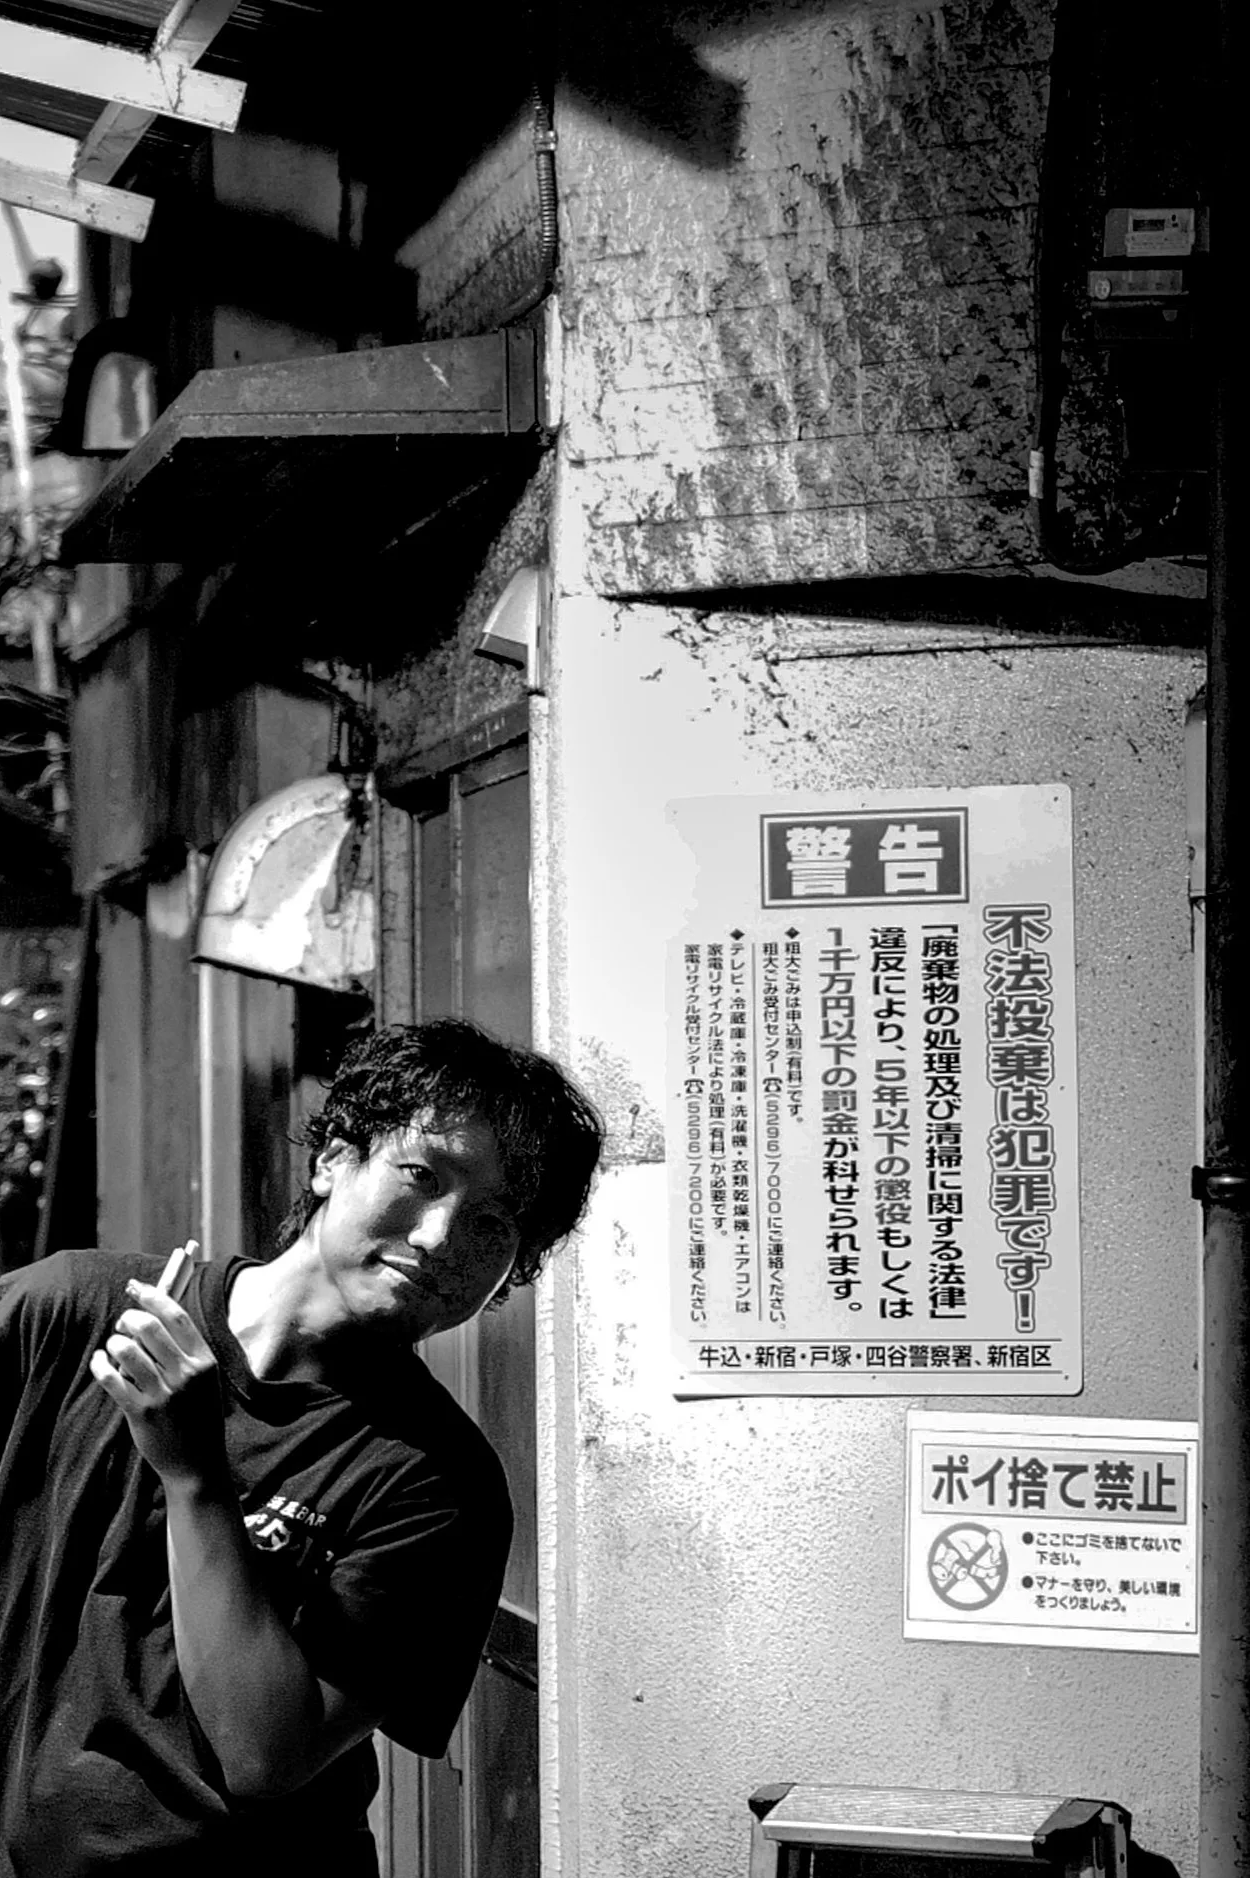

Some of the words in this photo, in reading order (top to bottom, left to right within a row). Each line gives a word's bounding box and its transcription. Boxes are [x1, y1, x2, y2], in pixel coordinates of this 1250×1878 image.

[786, 824, 944, 896] 警告
[818, 927, 862, 1311] 1千万円以下の罰金が科せられます。
[869, 926, 914, 1319] 違反により、5年以下の懲役もしくは
[921, 924, 967, 1319] 「廃棄物の処理及び清掃に関する法律」
[983, 904, 1057, 1333] 不法投棄は犯罪です!
[699, 1345, 1052, 1368] 牛込・新宿・戸塚・四谷警察署、新宿区
[932, 1454, 1177, 1513] ポイ捨て禁止
[1036, 1532, 1182, 1552] ここにゴミを捨てないで
[1036, 1550, 1081, 1566] 下さい。
[1035, 1575, 1181, 1597] マナーを守り、美しい環境
[1035, 1595, 1126, 1612] をつくりましょう。
